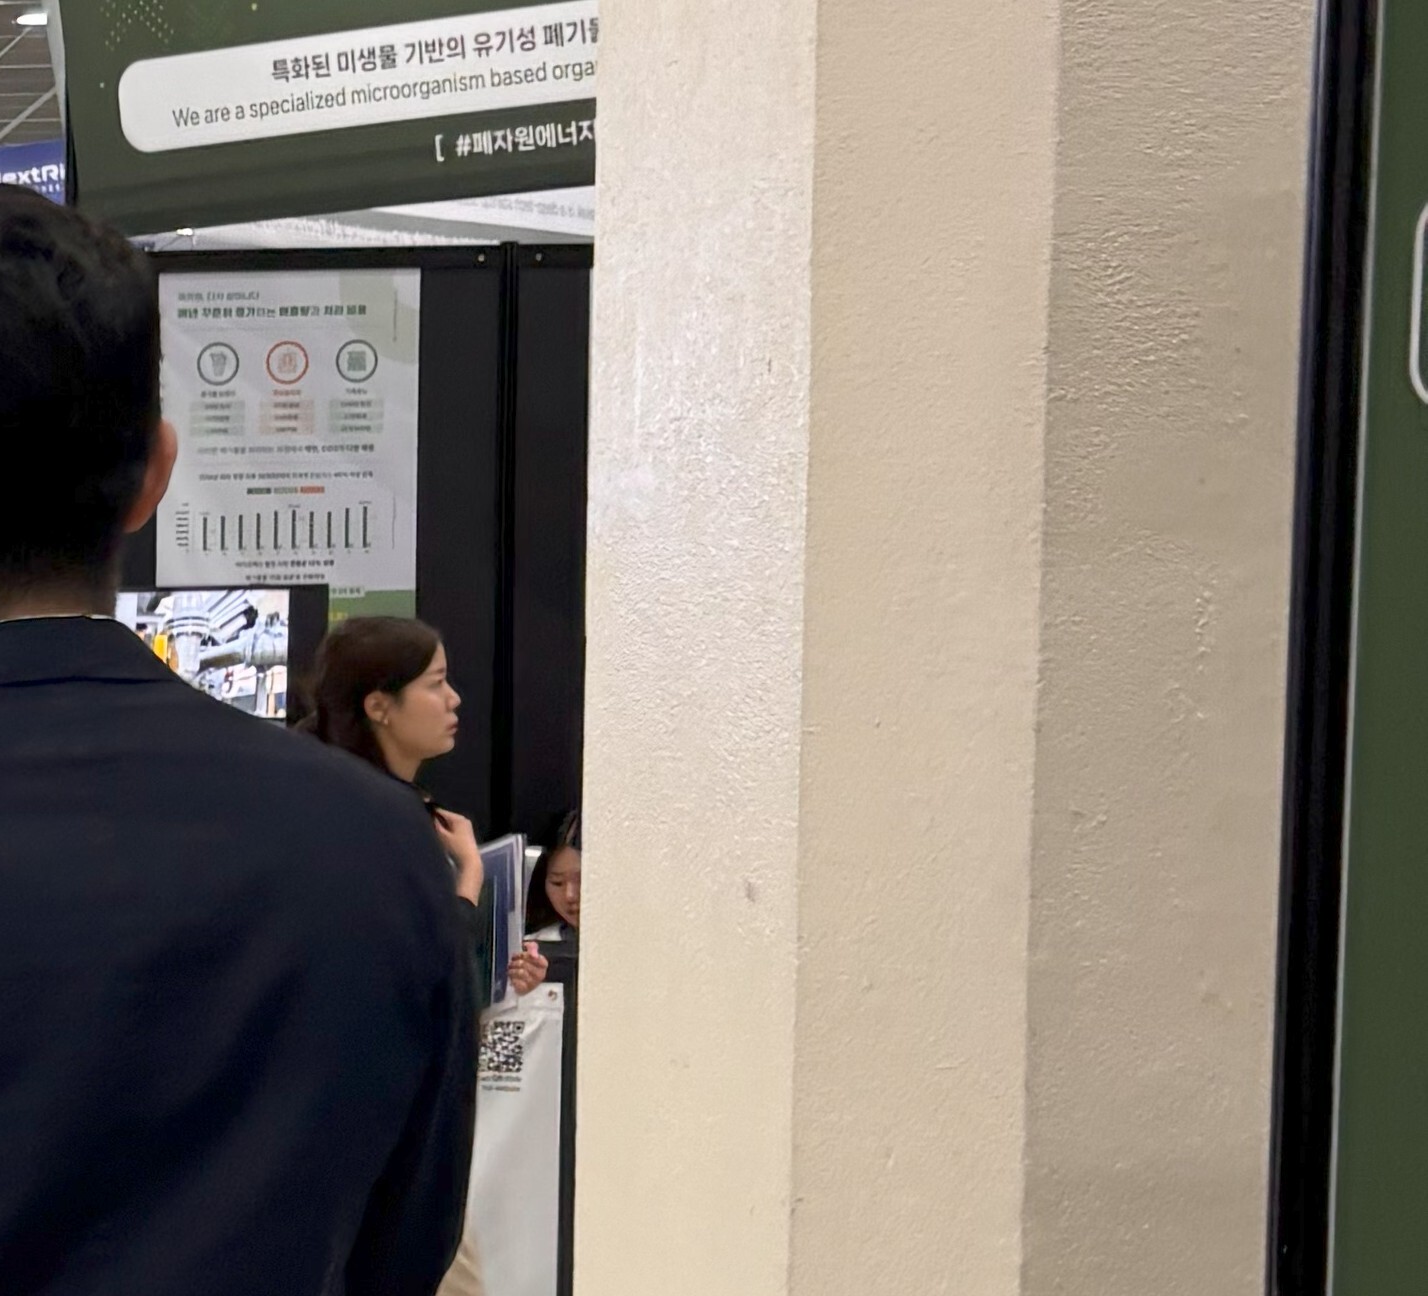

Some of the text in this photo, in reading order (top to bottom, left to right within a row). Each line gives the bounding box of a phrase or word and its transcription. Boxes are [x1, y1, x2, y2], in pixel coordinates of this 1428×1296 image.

[271, 52, 332, 83] 특화된
[337, 44, 398, 74] 미생물
[404, 34, 467, 65] 기반의
[473, 25, 537, 58] 유기성
[172, 60, 598, 129] We are a specialized microorganism based orga
